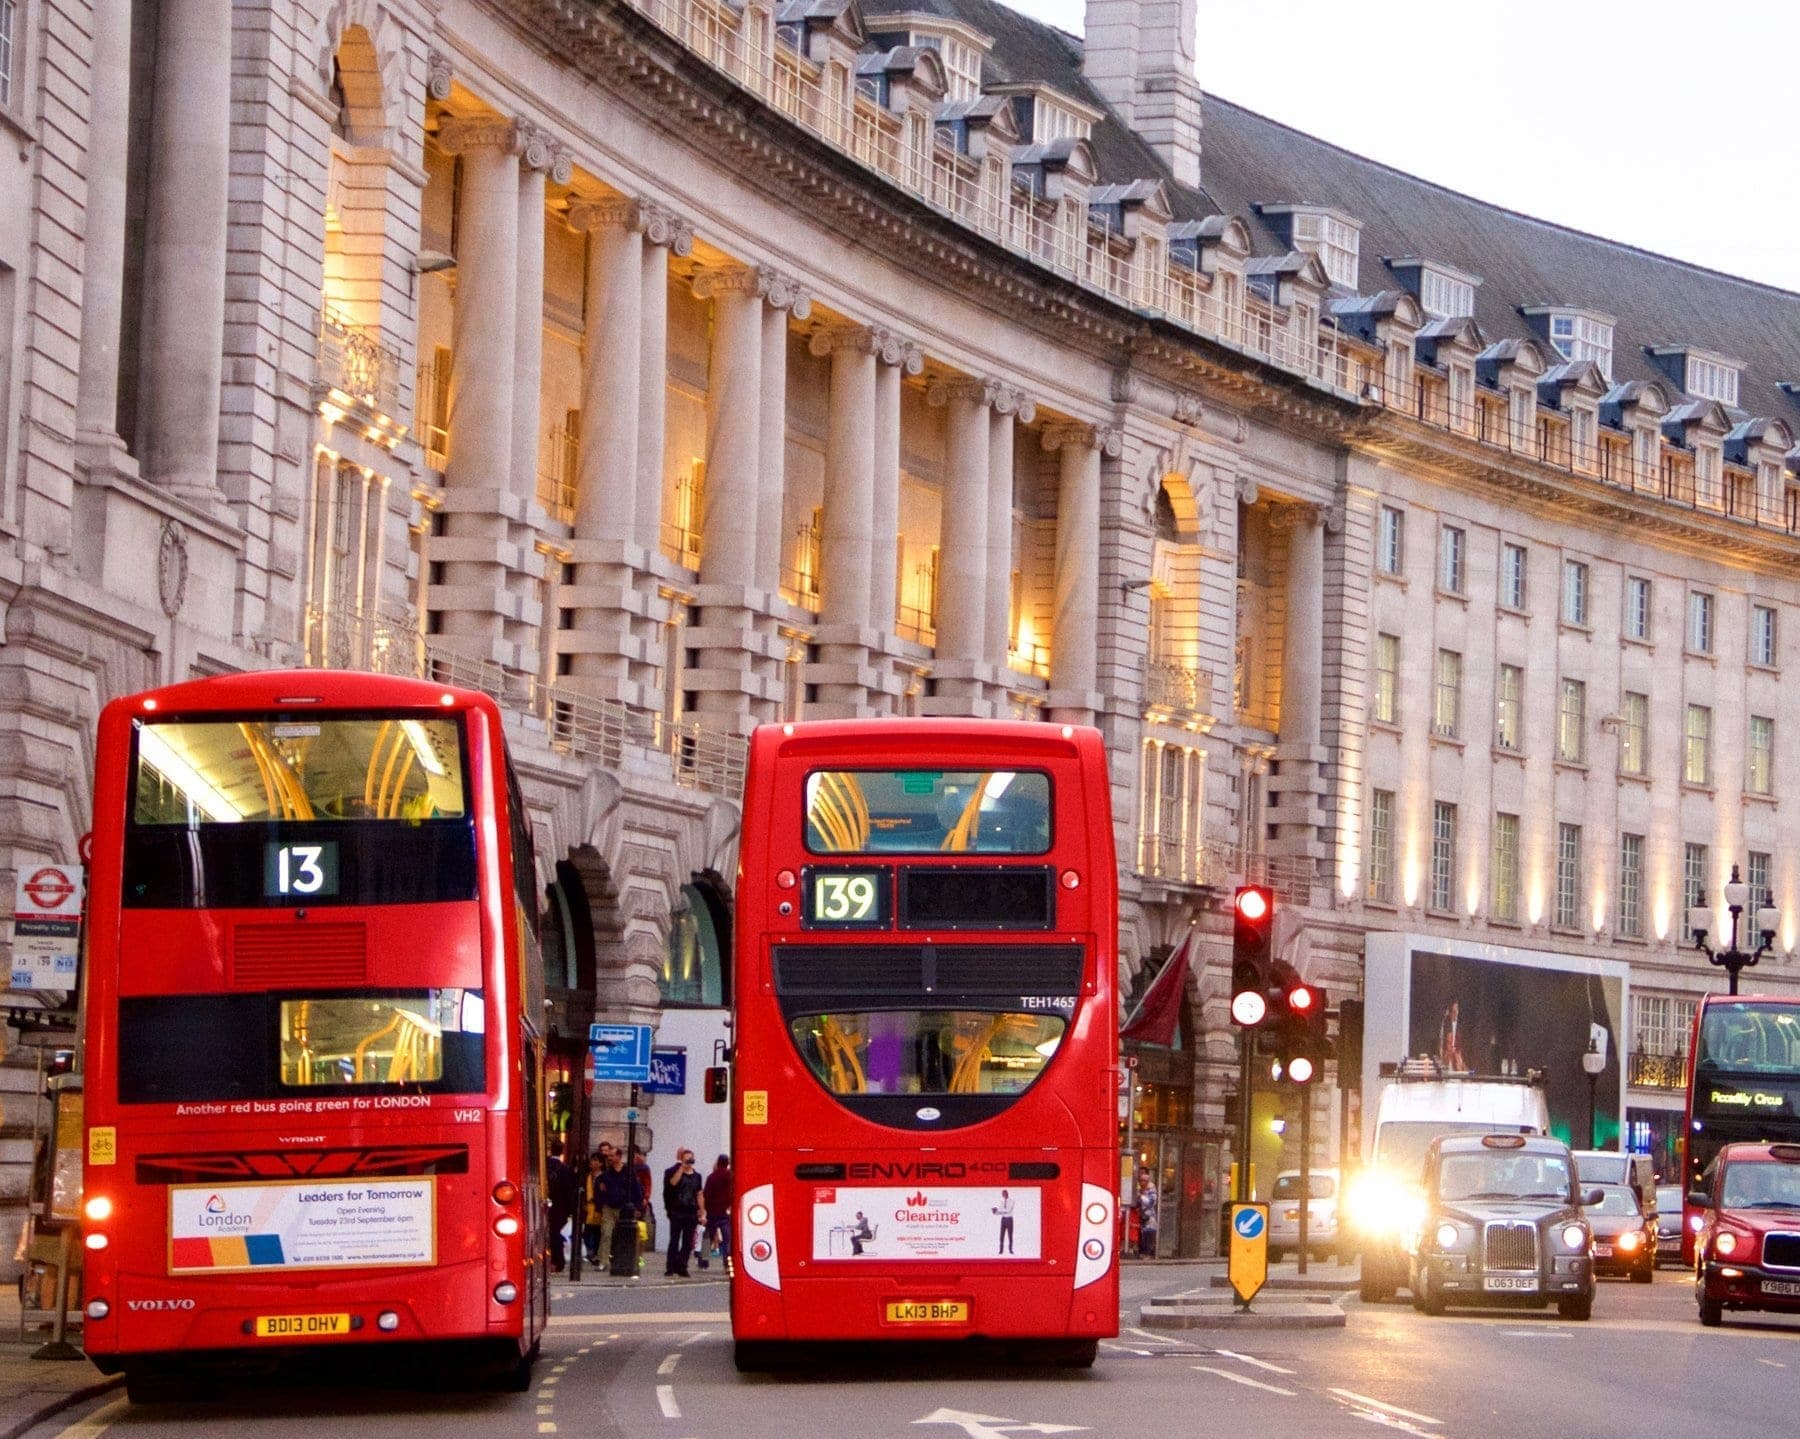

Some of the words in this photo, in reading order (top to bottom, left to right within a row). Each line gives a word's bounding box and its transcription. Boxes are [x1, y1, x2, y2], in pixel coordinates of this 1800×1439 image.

[279, 846, 324, 893] 13
[816, 877, 874, 919] 139
[1020, 996, 1075, 1008] TEH1465
[1130, 1057, 1138, 1067] D
[176, 1104, 227, 1116] Another
[231, 1102, 250, 1113] red
[254, 1101, 276, 1112] bus
[279, 1100, 312, 1113] going
[315, 1100, 349, 1112] green
[353, 1098, 371, 1109] for
[374, 1096, 431, 1109] LONDON
[1711, 1091, 1752, 1106] Piccadilly
[1754, 1093, 1783, 1105] Circus
[454, 1110, 481, 1122] VH2
[850, 1162, 966, 1179] ENVIRO
[298, 1190, 344, 1202] Leaders
[347, 1190, 363, 1201] for
[366, 1189, 423, 1200] Tomorrow
[337, 1207, 356, 1215] Open
[358, 1206, 385, 1215] Evening
[895, 1209, 960, 1225] Clearing
[199, 1212, 252, 1227] London
[309, 1218, 337, 1227] Tuesday
[339, 1217, 356, 1225] 23rd
[357, 1215, 395, 1225] September
[128, 1299, 195, 1311] VOLVO
[895, 1305, 927, 1319] LK13
[931, 1304, 958, 1318] BHP
[267, 1318, 302, 1334] BD13
[307, 1316, 338, 1331] OHV
